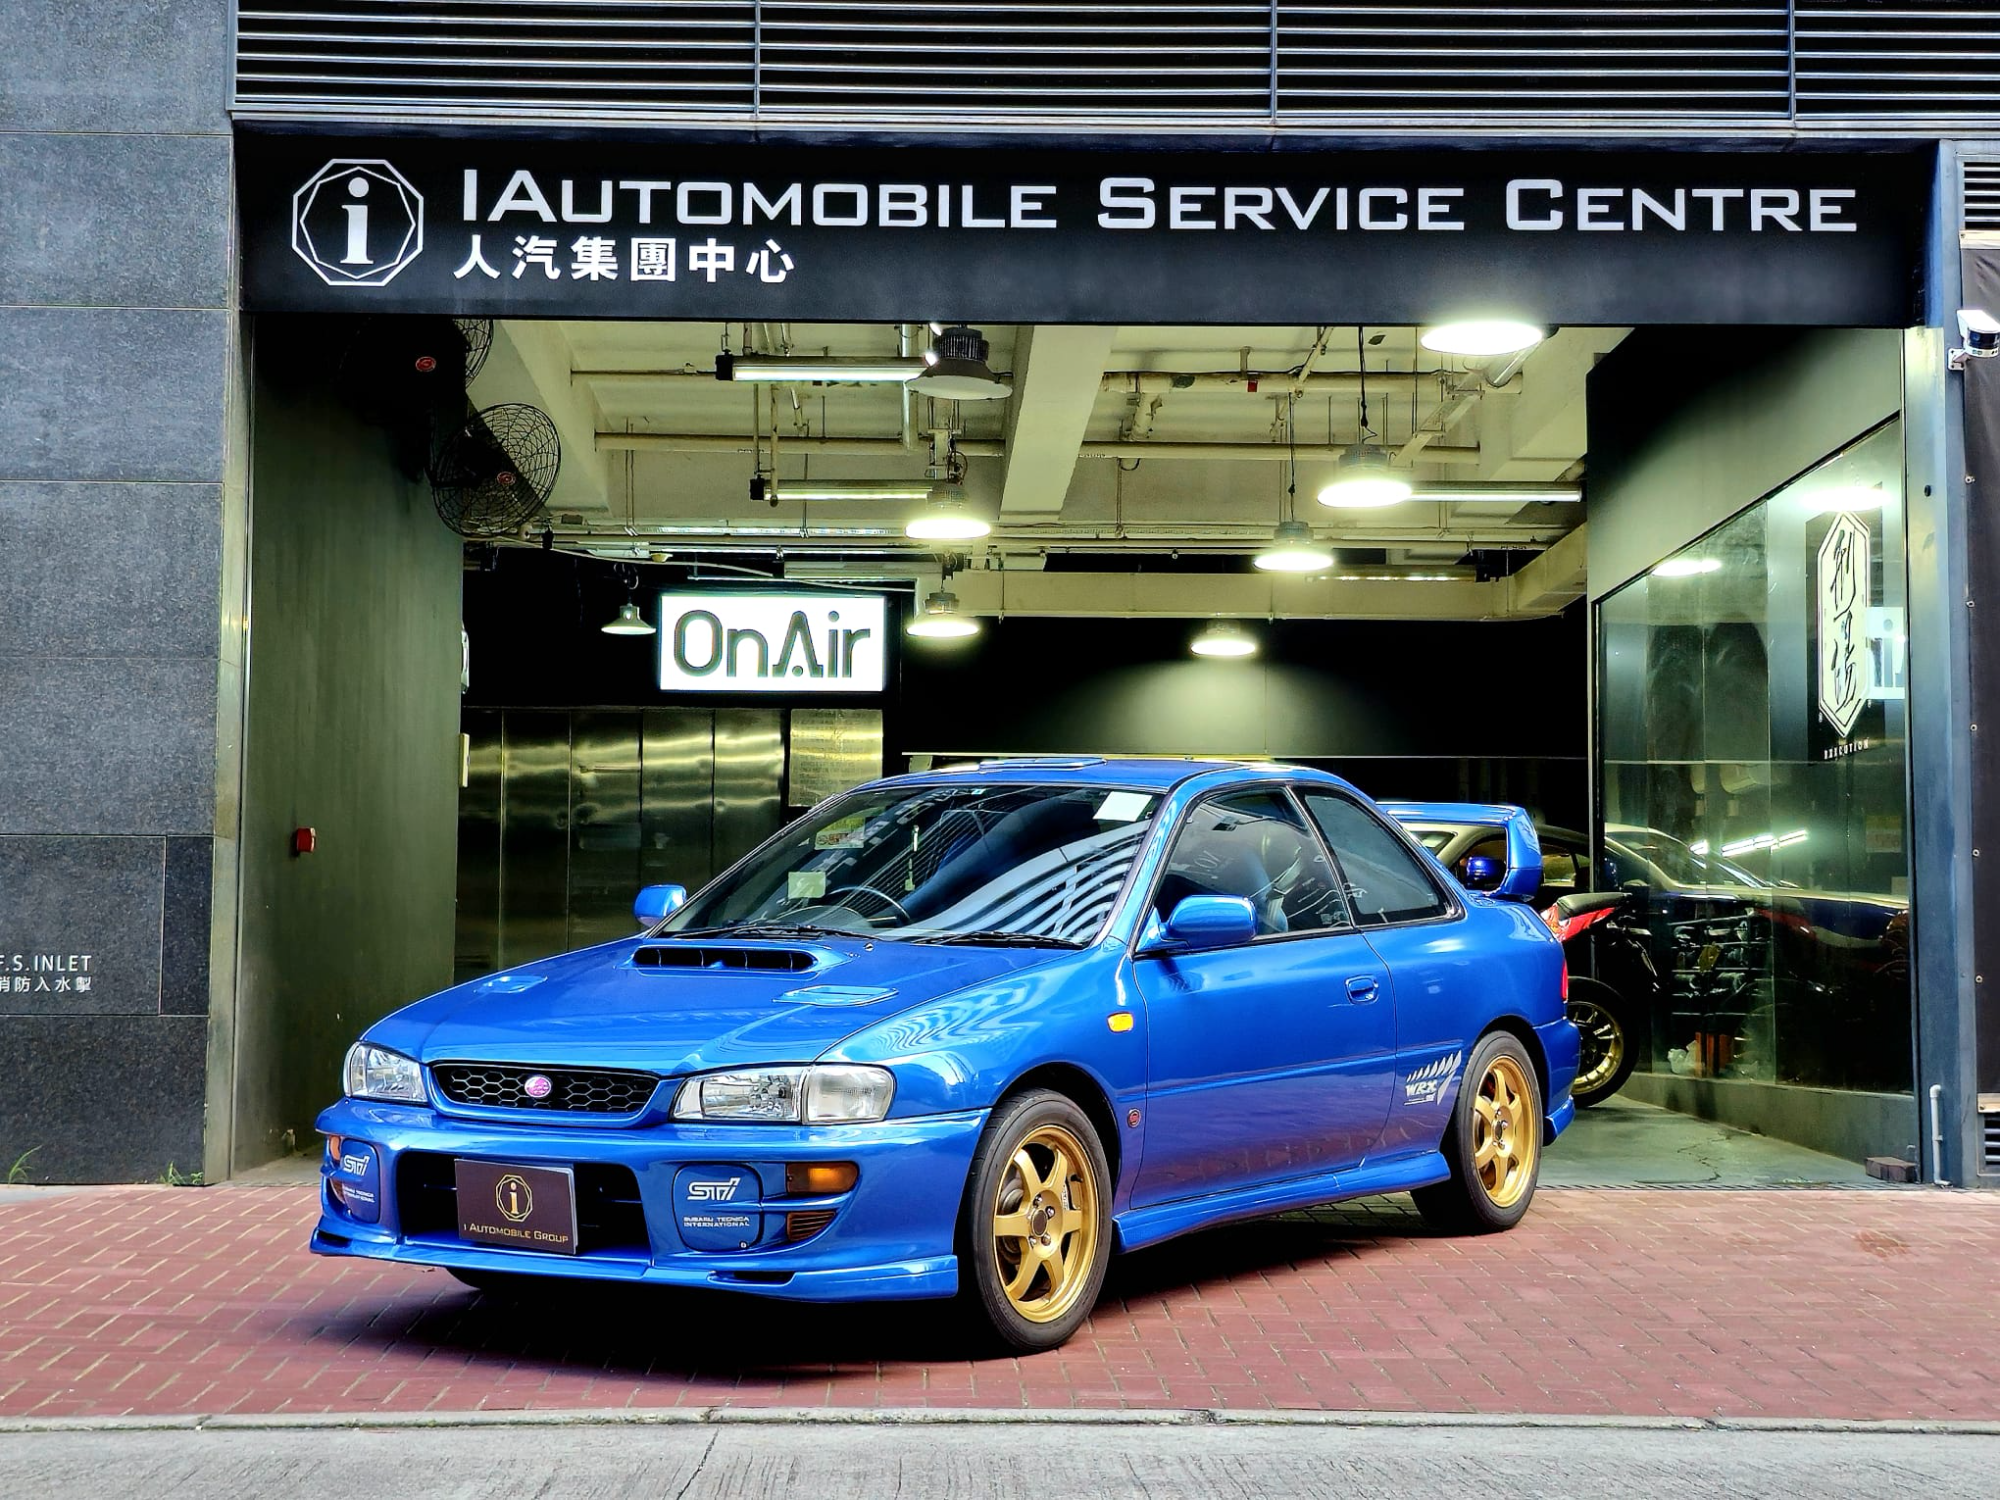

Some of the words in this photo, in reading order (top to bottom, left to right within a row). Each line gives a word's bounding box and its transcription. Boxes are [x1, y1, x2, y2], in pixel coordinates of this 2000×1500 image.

[1097, 177, 1465, 231] SERVICE
[1506, 178, 1857, 232] CENTRE
[453, 234, 795, 283] 人汽集團中心
[469, 1222, 532, 1239] AUTOMOBILE
[533, 1230, 569, 1243] GROUP
